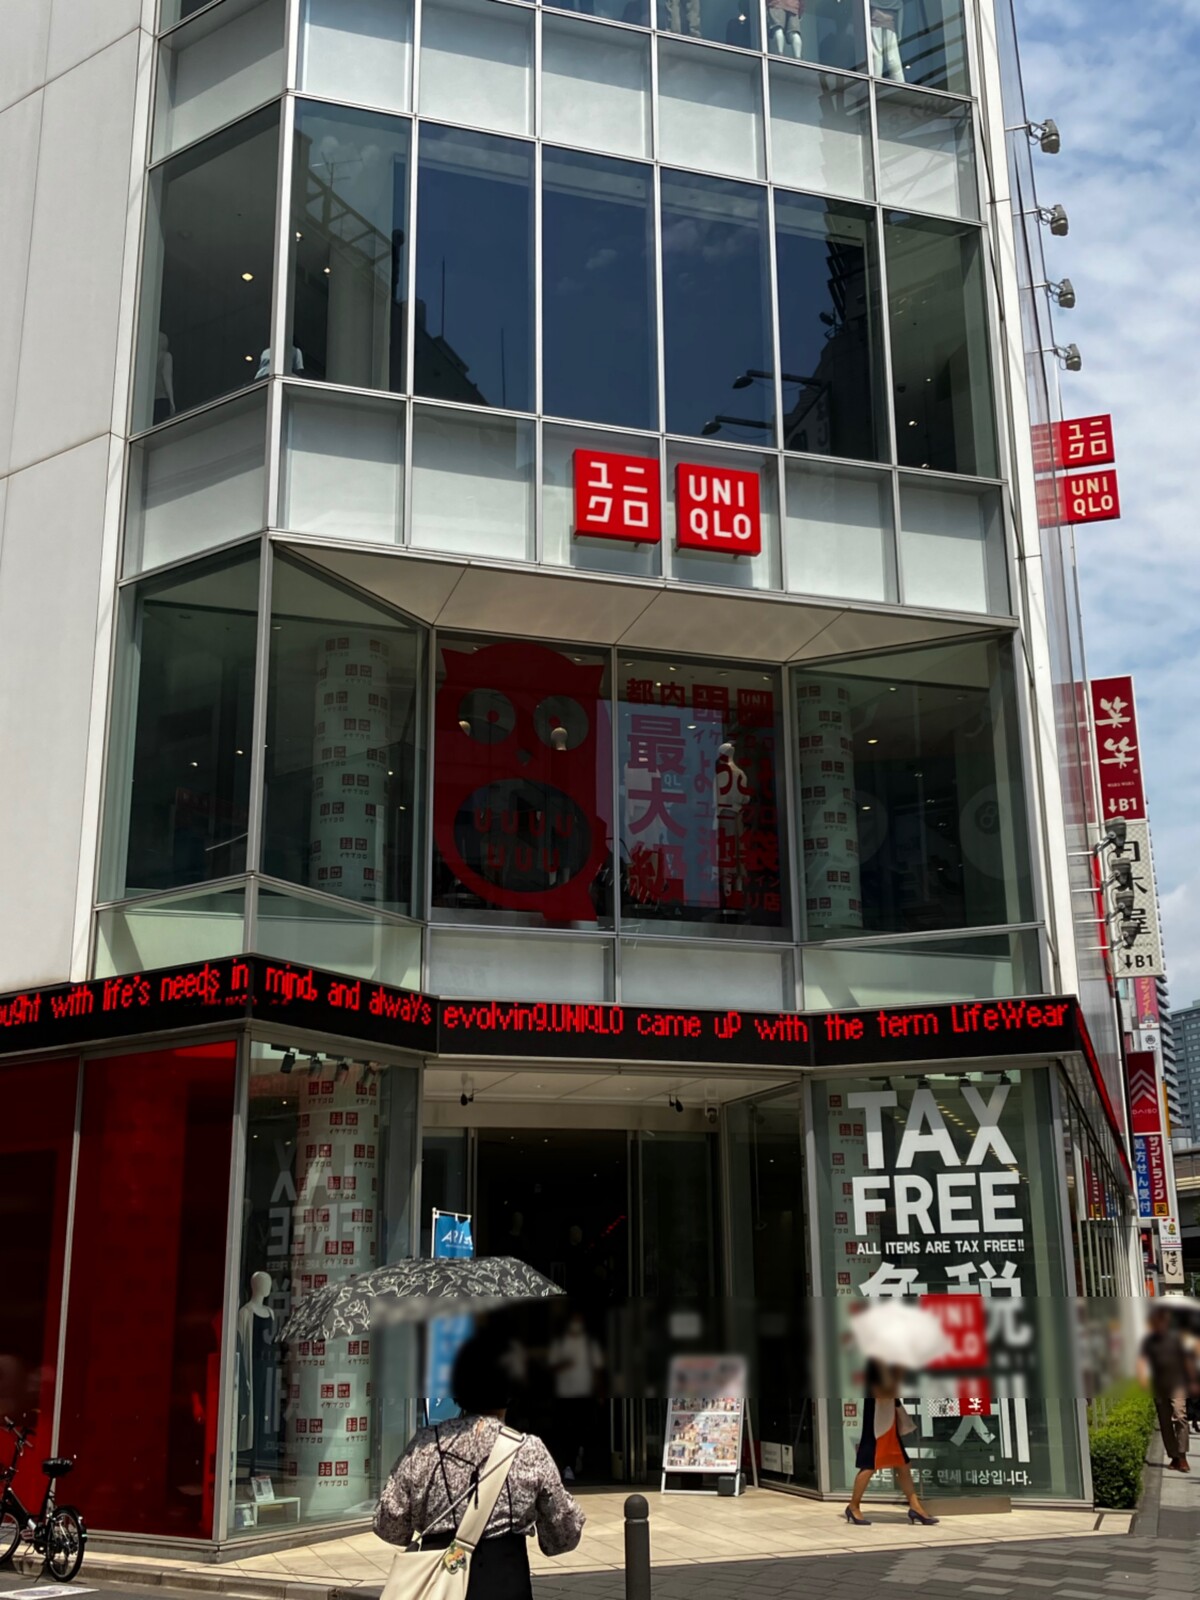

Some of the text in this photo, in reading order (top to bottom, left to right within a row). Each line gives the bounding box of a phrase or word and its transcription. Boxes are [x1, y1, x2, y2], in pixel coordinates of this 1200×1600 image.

[1068, 420, 1106, 441] ユニ
[1069, 439, 1107, 459] クロ
[587, 461, 648, 493] ユニ
[688, 474, 745, 507] UNI
[1071, 476, 1109, 496] UNI
[586, 495, 649, 527] クロ
[1073, 494, 1114, 516] QLO
[689, 508, 752, 540] QLO
[1095, 696, 1138, 769] 笑笑
[1118, 797, 1138, 812] B1
[1135, 955, 1154, 968] B1
[51, 985, 94, 1019] with
[103, 973, 151, 1012] life's
[160, 963, 221, 1002] needs
[231, 959, 249, 991] in
[265, 964, 318, 1001] mind,
[328, 980, 361, 1011] and
[369, 986, 432, 1025] always
[637, 1012, 702, 1038] came
[754, 1013, 810, 1042] with
[824, 1013, 864, 1041] the
[876, 1010, 939, 1038] term
[951, 1000, 1069, 1033] LifeWear
[847, 1085, 1019, 1170] TAX
[1133, 1138, 1151, 1214] 処方せん受付
[1148, 1136, 1165, 1201] サンドラッグ
[851, 1171, 1025, 1236] FREE
[857, 1238, 1025, 1256] ALL ITEMS ARE TAX FREE!!
